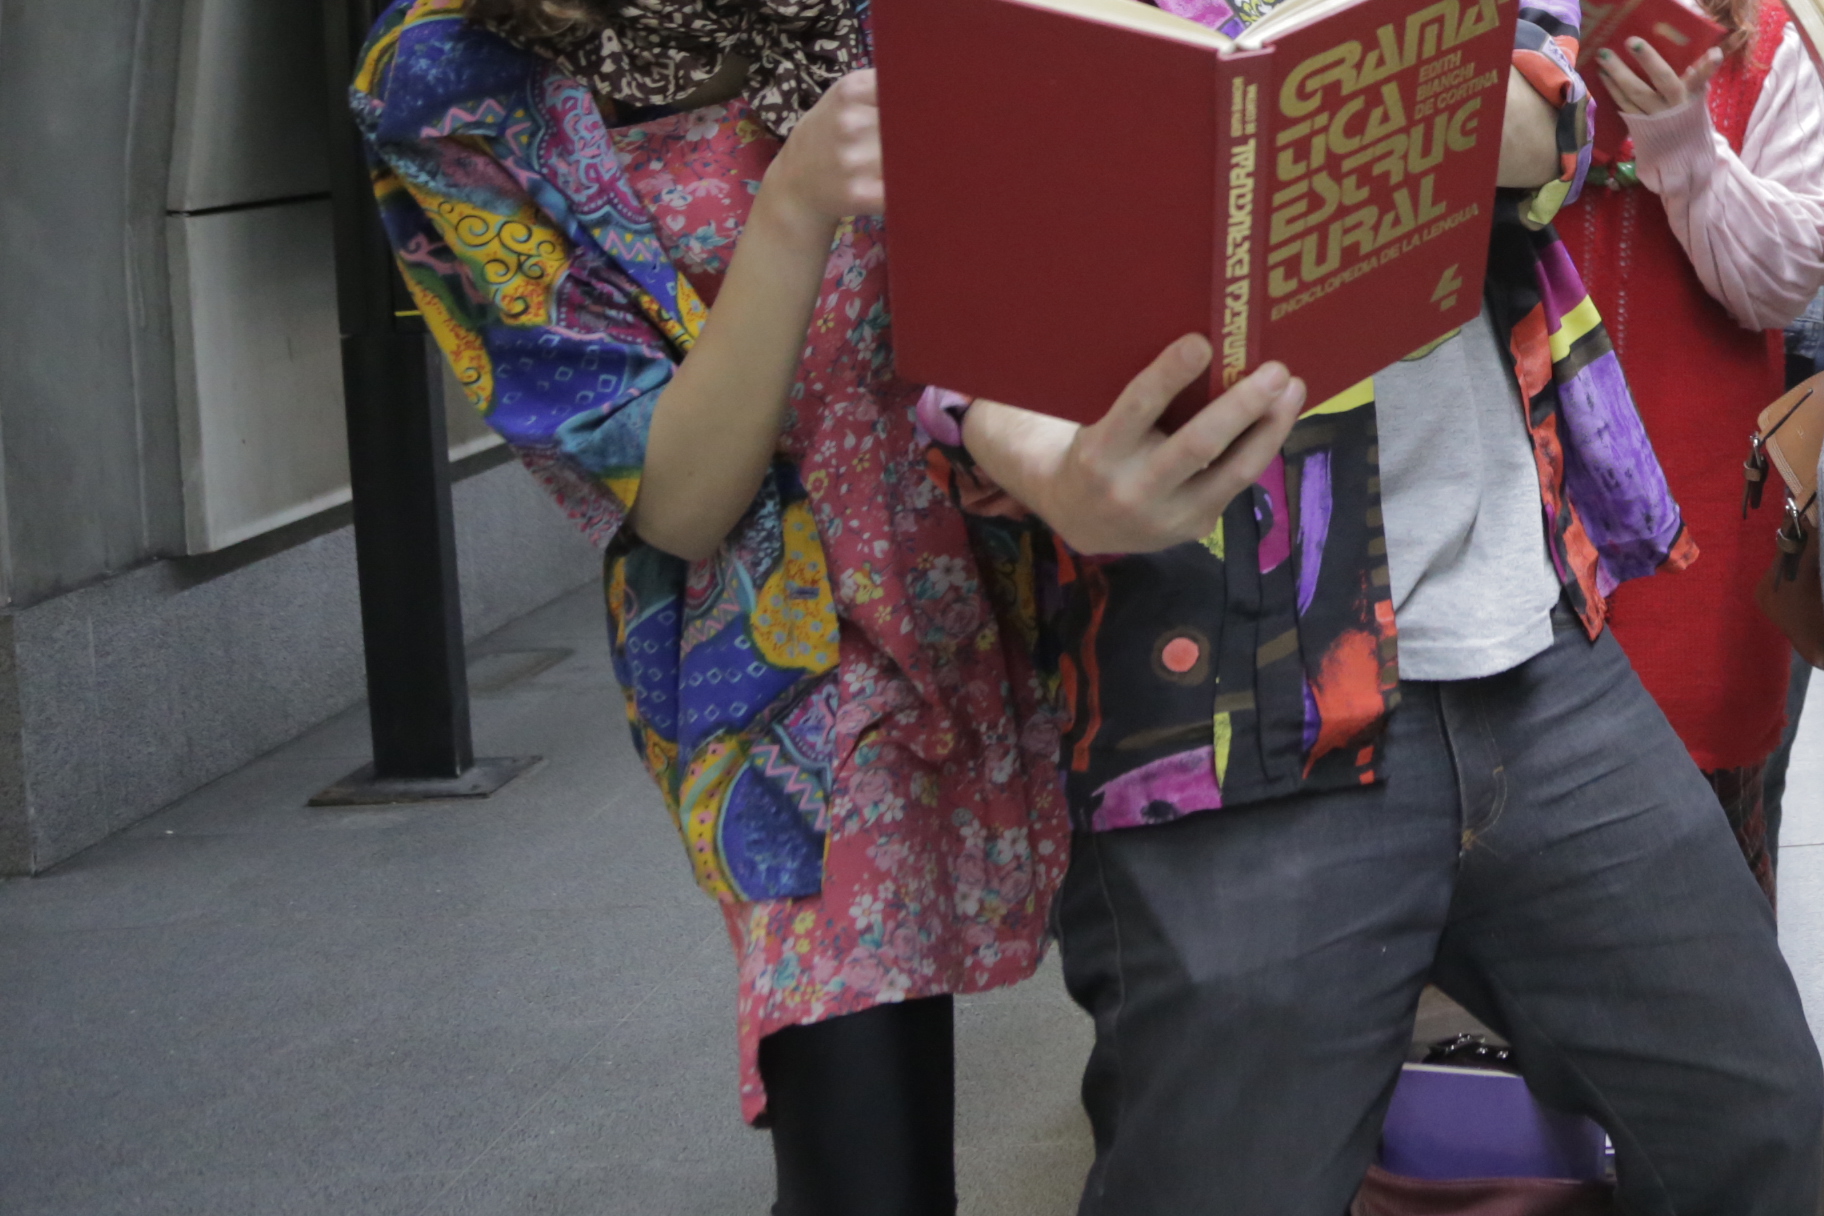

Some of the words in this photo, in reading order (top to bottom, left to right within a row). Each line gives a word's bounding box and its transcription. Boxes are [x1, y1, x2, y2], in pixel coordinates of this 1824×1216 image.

[1416, 61, 1475, 102] BIANCHI
[1418, 49, 1462, 83] EDITH
[1414, 97, 1435, 120] DE
[1437, 68, 1499, 109] CORTINA
[1267, 173, 1447, 298] TURAL
[1270, 256, 1379, 322] ENCICLOPEDIA
[1380, 244, 1401, 265] DE
[1402, 234, 1422, 253] LA
[1423, 203, 1480, 241] LENGUA
